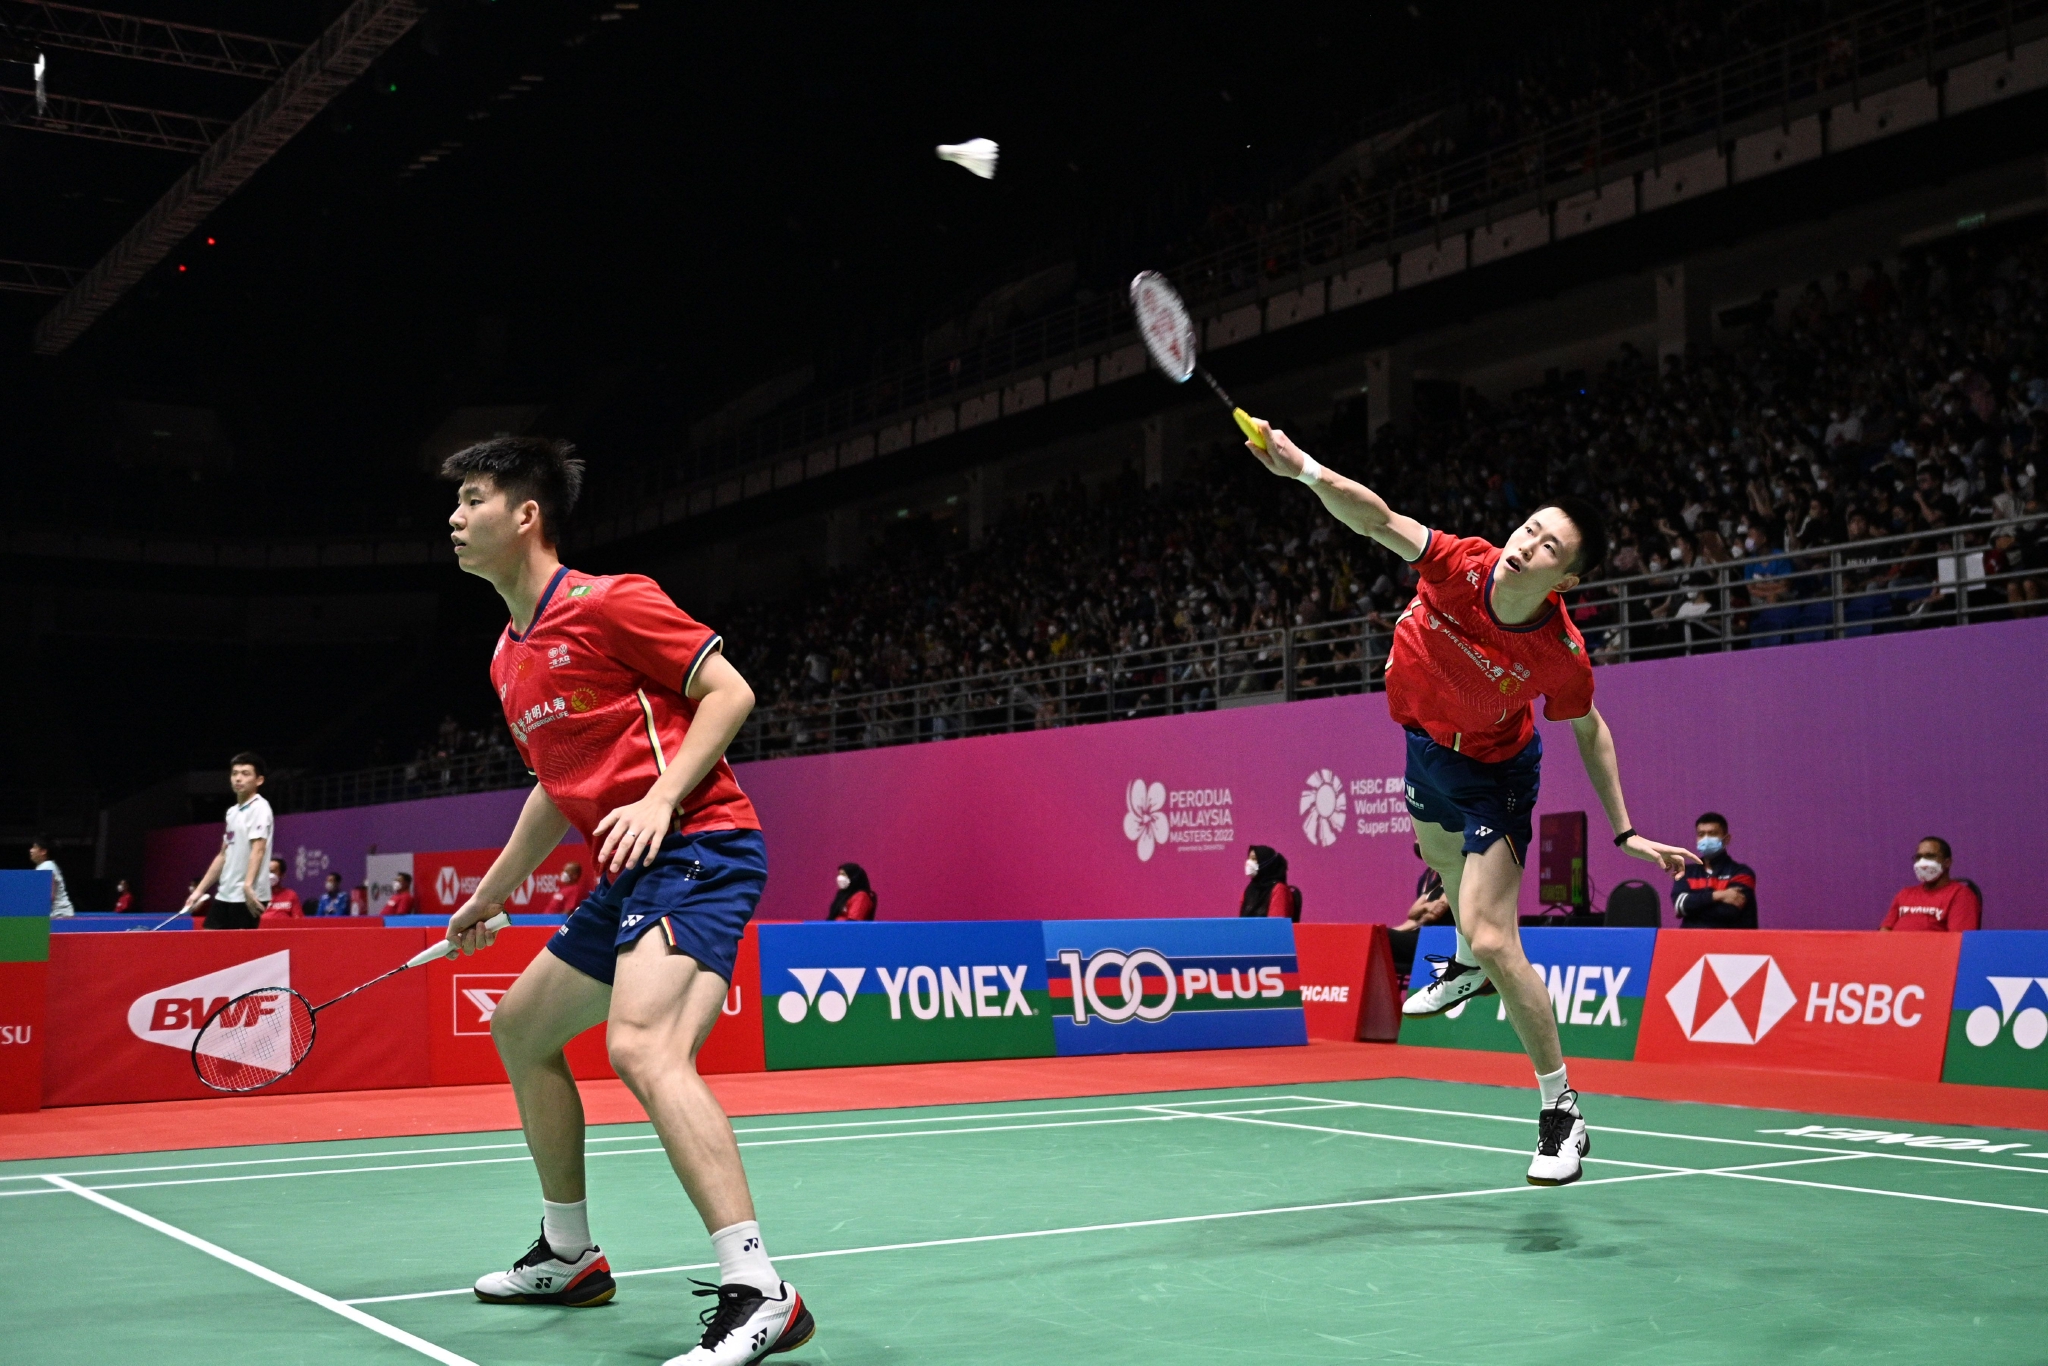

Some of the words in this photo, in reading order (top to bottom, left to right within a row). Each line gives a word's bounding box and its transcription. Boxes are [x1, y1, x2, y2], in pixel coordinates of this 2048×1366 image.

[1350, 778, 1383, 795] HSBC
[1384, 776, 1406, 794] BW
[1169, 787, 1233, 808] PERODUA
[1353, 799, 1387, 815] World
[1389, 797, 1409, 813] Tou
[1169, 808, 1233, 827] MALAYSIA
[1357, 818, 1390, 838] Super
[1390, 816, 1412, 833] 500
[1169, 829, 1213, 843] MASTERS
[1213, 828, 1235, 842] 2022
[876, 965, 1034, 1020] YONEX
[1060, 948, 1177, 1024] 100
[1182, 966, 1285, 1000] PLUS
[1299, 985, 1350, 1003] HCARE
[1497, 963, 1632, 1027] NEX
[149, 994, 279, 1032] BWF
[1804, 981, 1926, 1028] HSBC
[0, 1025, 32, 1045] SU
[1754, 1125, 2032, 1153] YONEX
